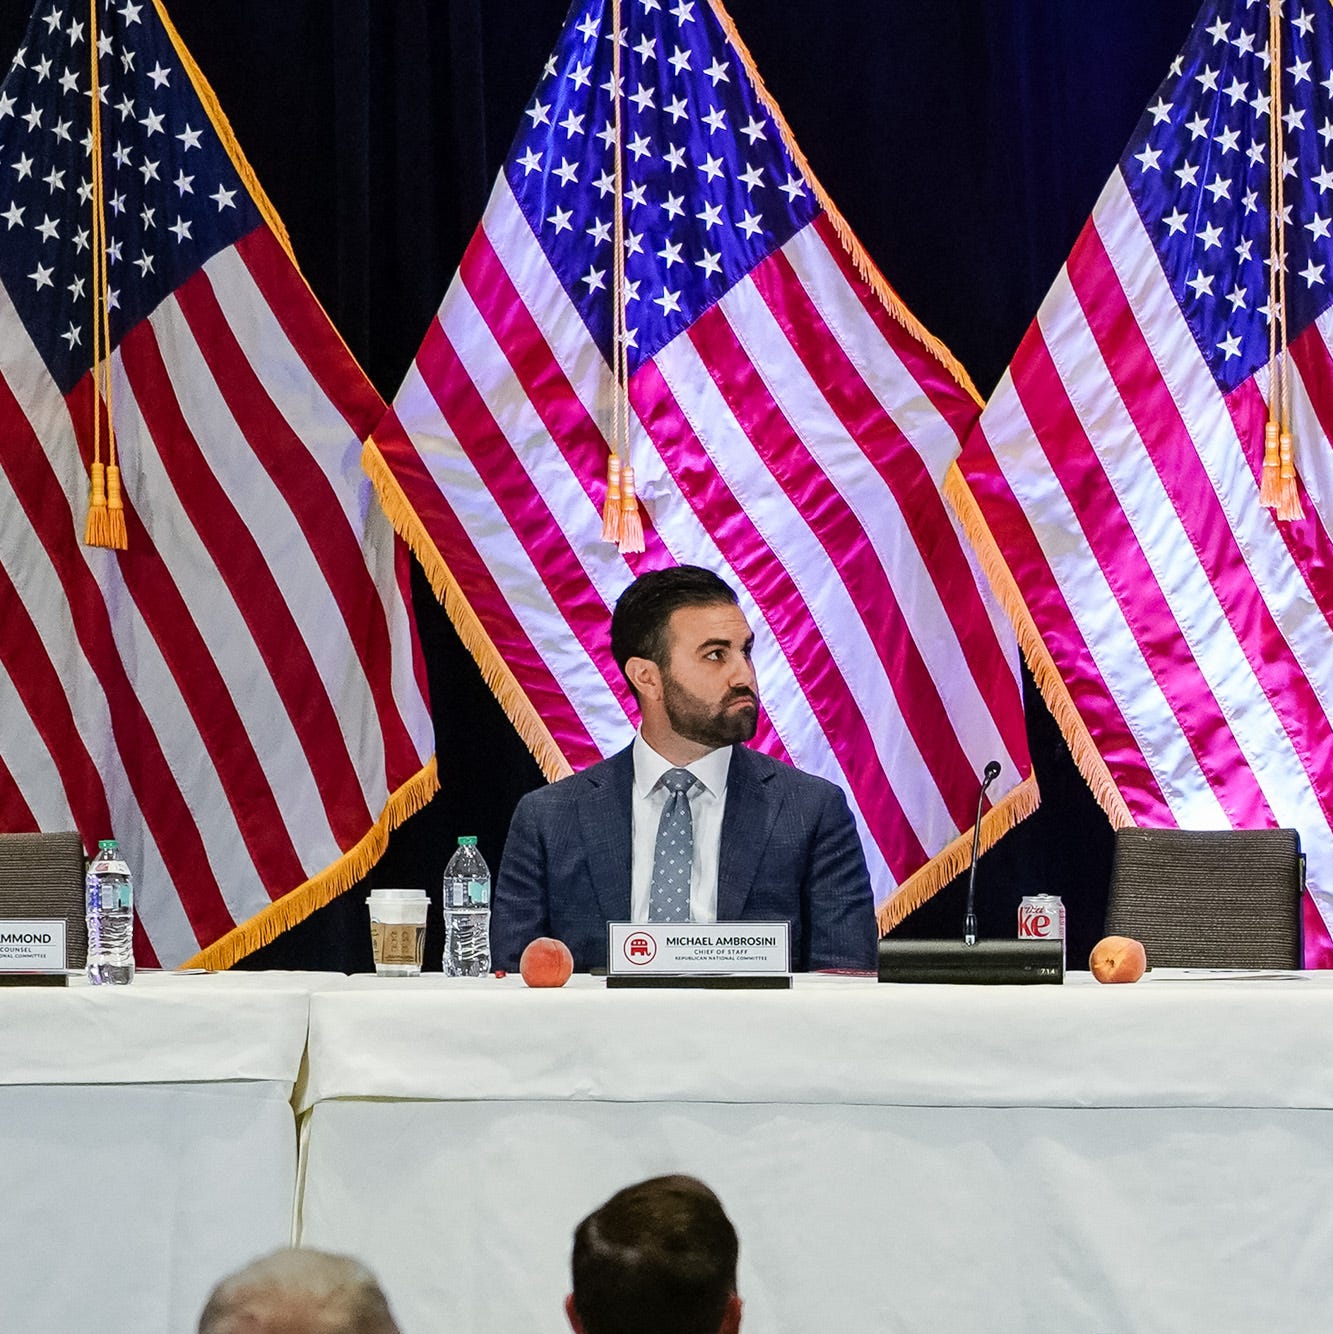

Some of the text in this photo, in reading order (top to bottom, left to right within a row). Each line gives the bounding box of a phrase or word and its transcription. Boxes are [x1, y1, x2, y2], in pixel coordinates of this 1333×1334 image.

[0, 934, 51, 944] MMOND
[666, 937, 776, 946] MICHAEL AMBROSINI
